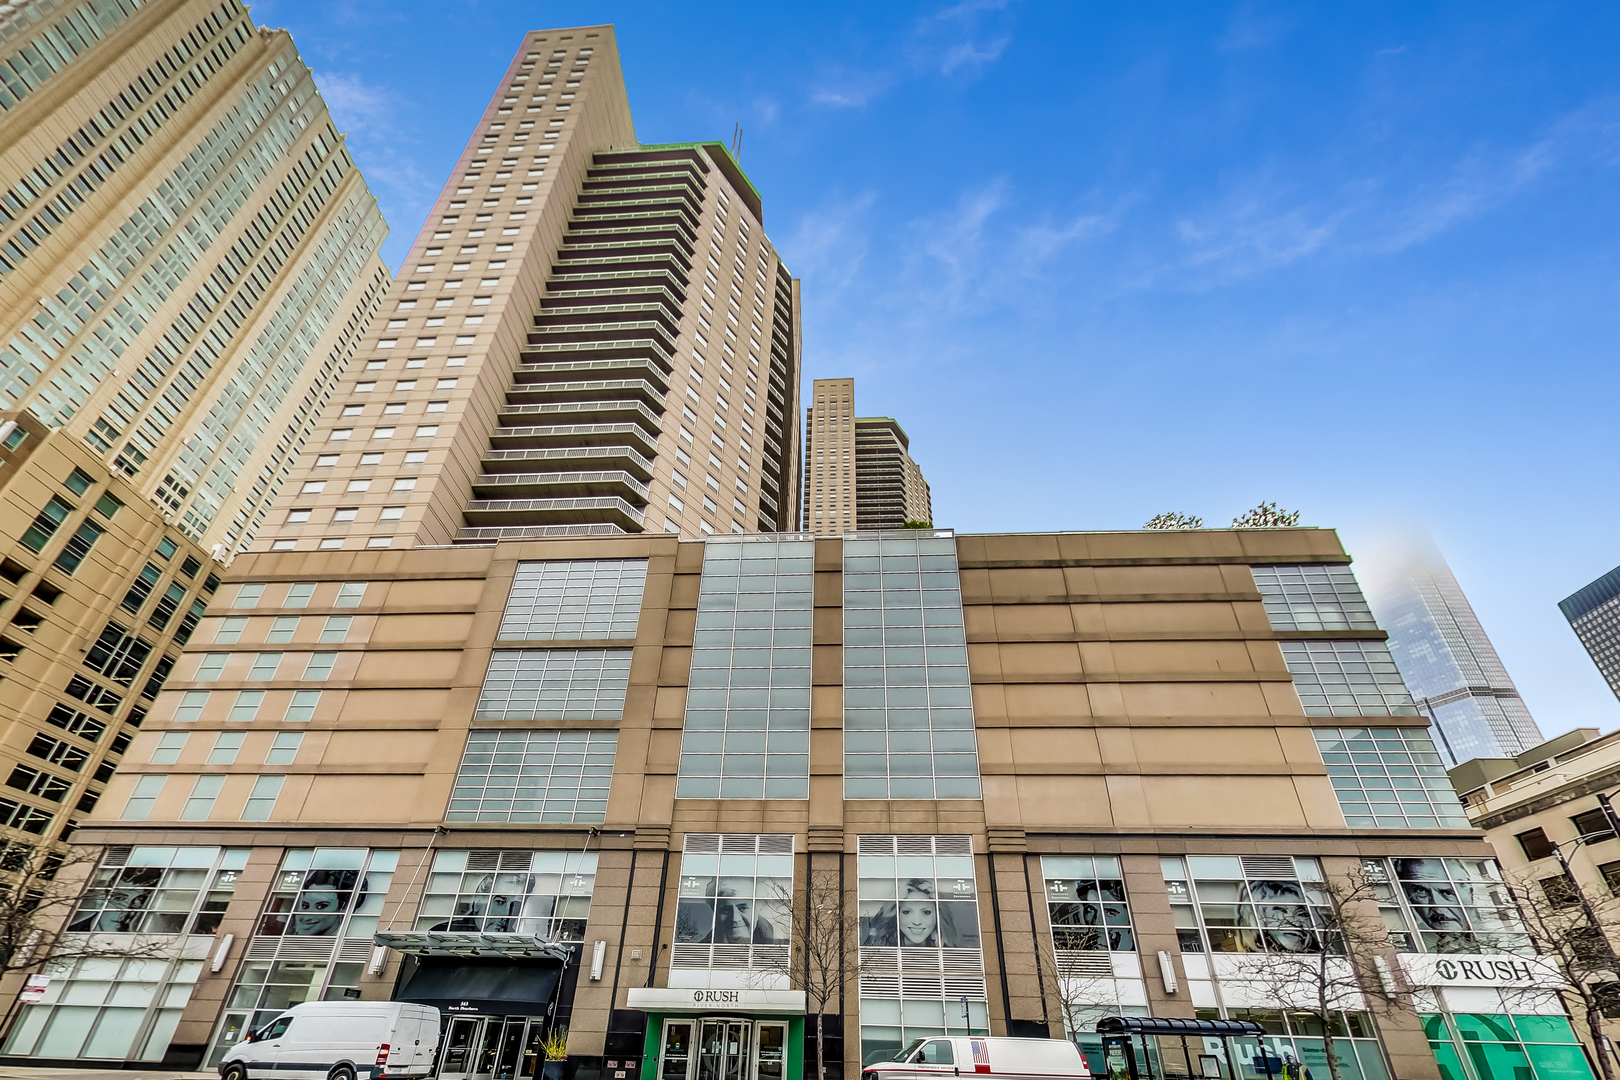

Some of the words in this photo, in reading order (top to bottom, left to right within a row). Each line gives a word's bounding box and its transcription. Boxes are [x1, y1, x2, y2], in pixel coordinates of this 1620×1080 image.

[1457, 960, 1535, 981] RUSH
[705, 990, 739, 1002] RUSH
[1202, 1036, 1295, 1065] Rush
